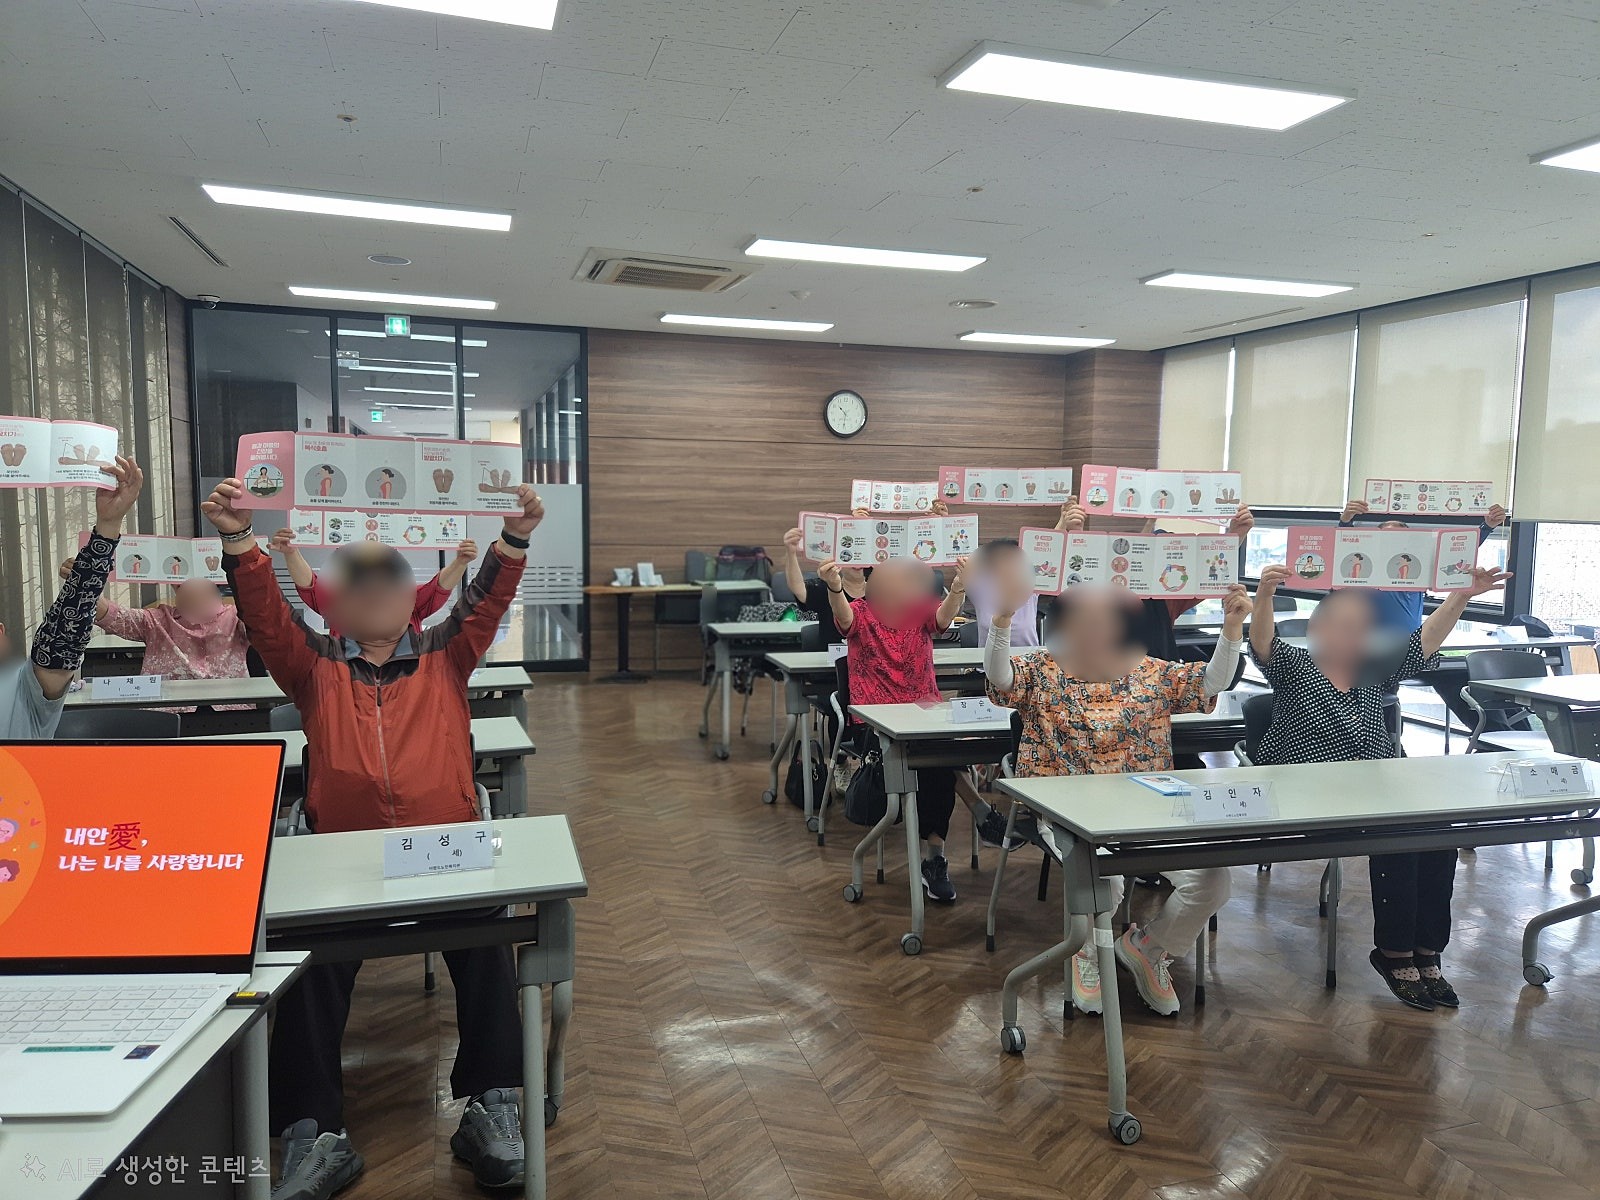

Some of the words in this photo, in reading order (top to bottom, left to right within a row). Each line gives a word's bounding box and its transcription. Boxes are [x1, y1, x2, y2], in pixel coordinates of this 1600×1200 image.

[1203, 790, 1212, 800] 김
[1228, 788, 1236, 799] 인
[1252, 787, 1262, 797] 자
[401, 838, 412, 850] 김
[438, 834, 450, 846] 성
[475, 831, 486, 843] 구
[58, 856, 97, 872] 나는
[103, 856, 142, 871] 나를
[147, 853, 244, 871] 사랑합니다
